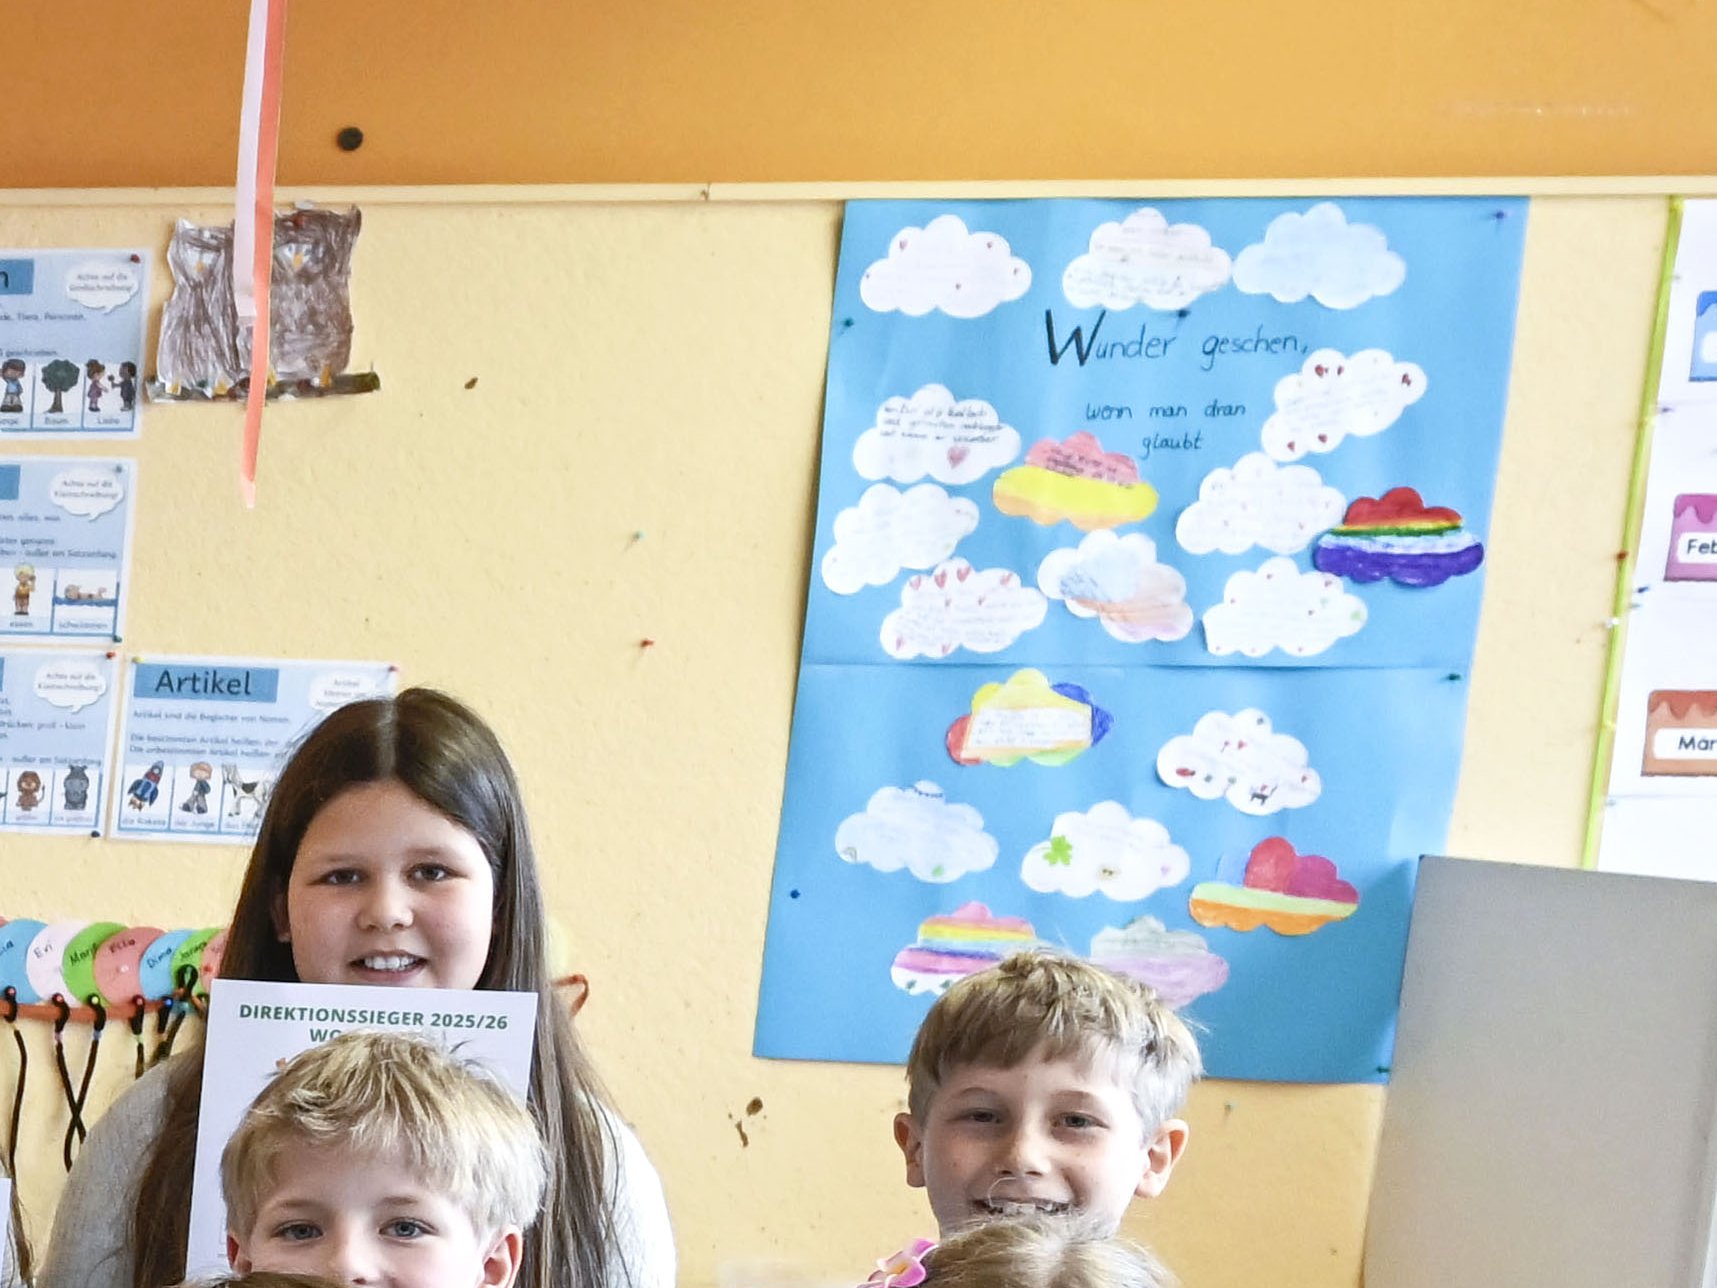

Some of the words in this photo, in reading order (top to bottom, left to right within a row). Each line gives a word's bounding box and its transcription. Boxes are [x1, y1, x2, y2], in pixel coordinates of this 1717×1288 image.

[1046, 309, 1176, 366] Wunder
[1150, 403, 1188, 422] man
[1205, 401, 1247, 419] dran
[1140, 432, 1202, 459] glaubt
[154, 670, 251, 697] Artikel
